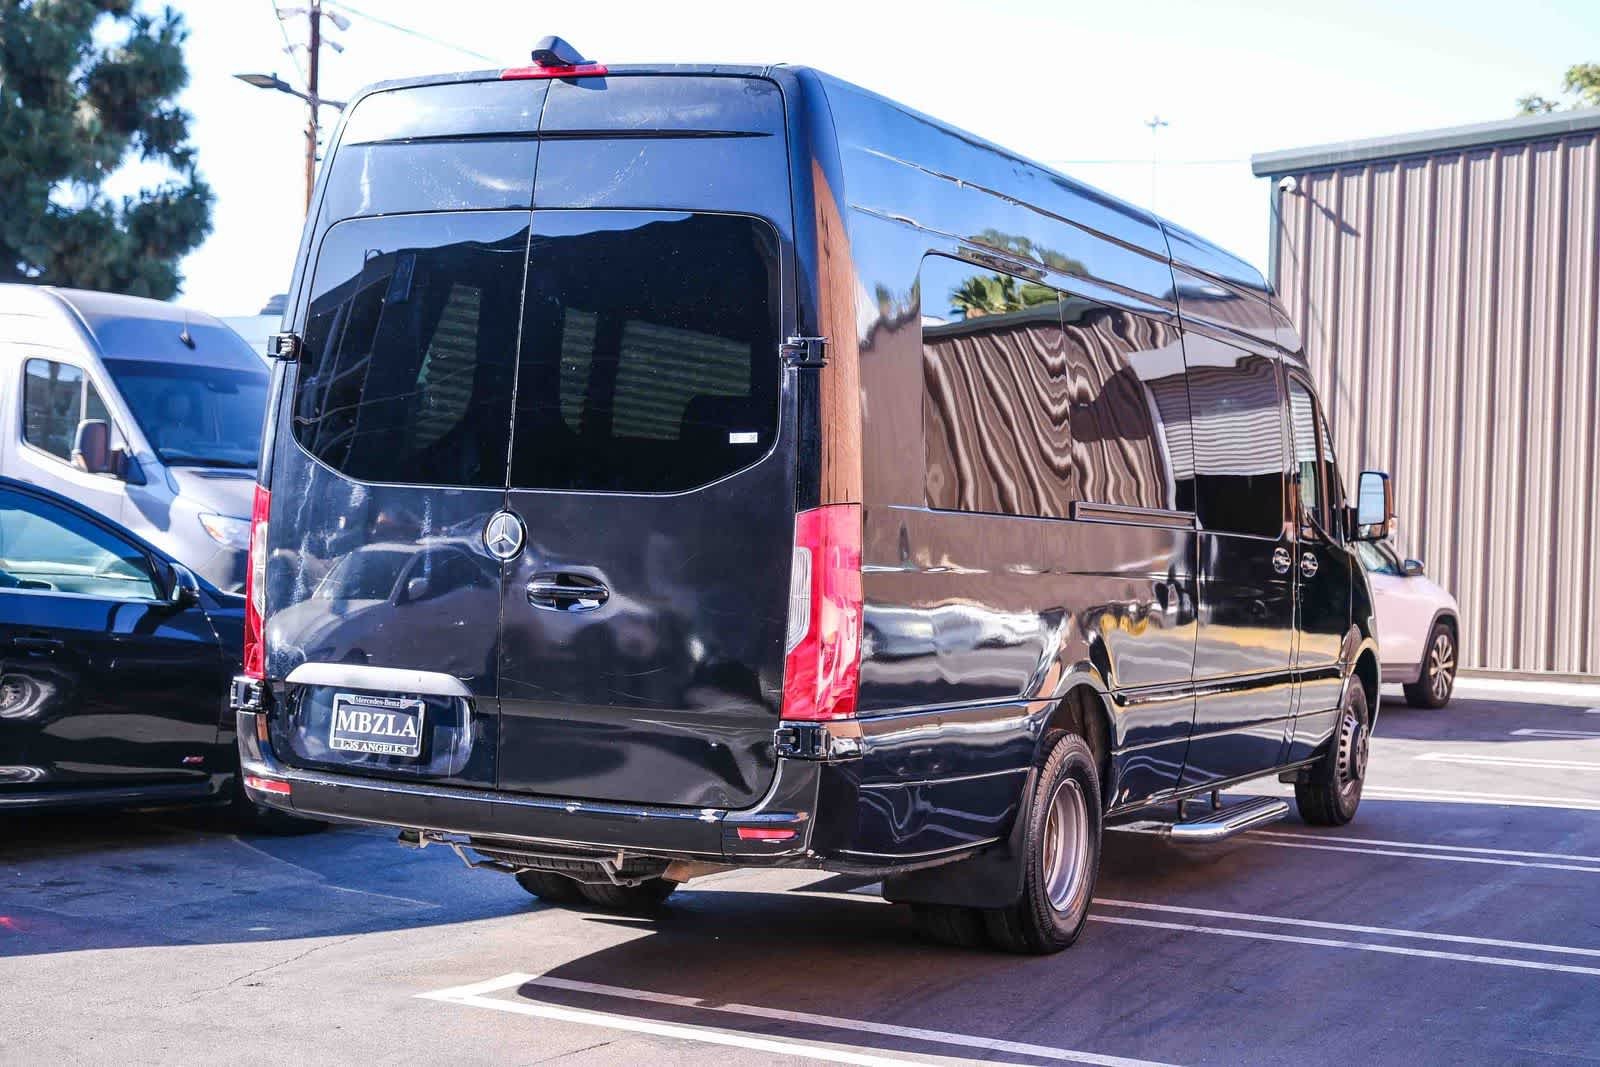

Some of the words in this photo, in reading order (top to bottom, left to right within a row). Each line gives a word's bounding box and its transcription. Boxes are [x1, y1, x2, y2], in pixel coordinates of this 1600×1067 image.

[354, 696, 401, 707] Mercedes-Benz
[336, 710, 417, 737] MBZLA
[342, 741, 359, 750] LOS
[360, 742, 407, 754] ANGELES
